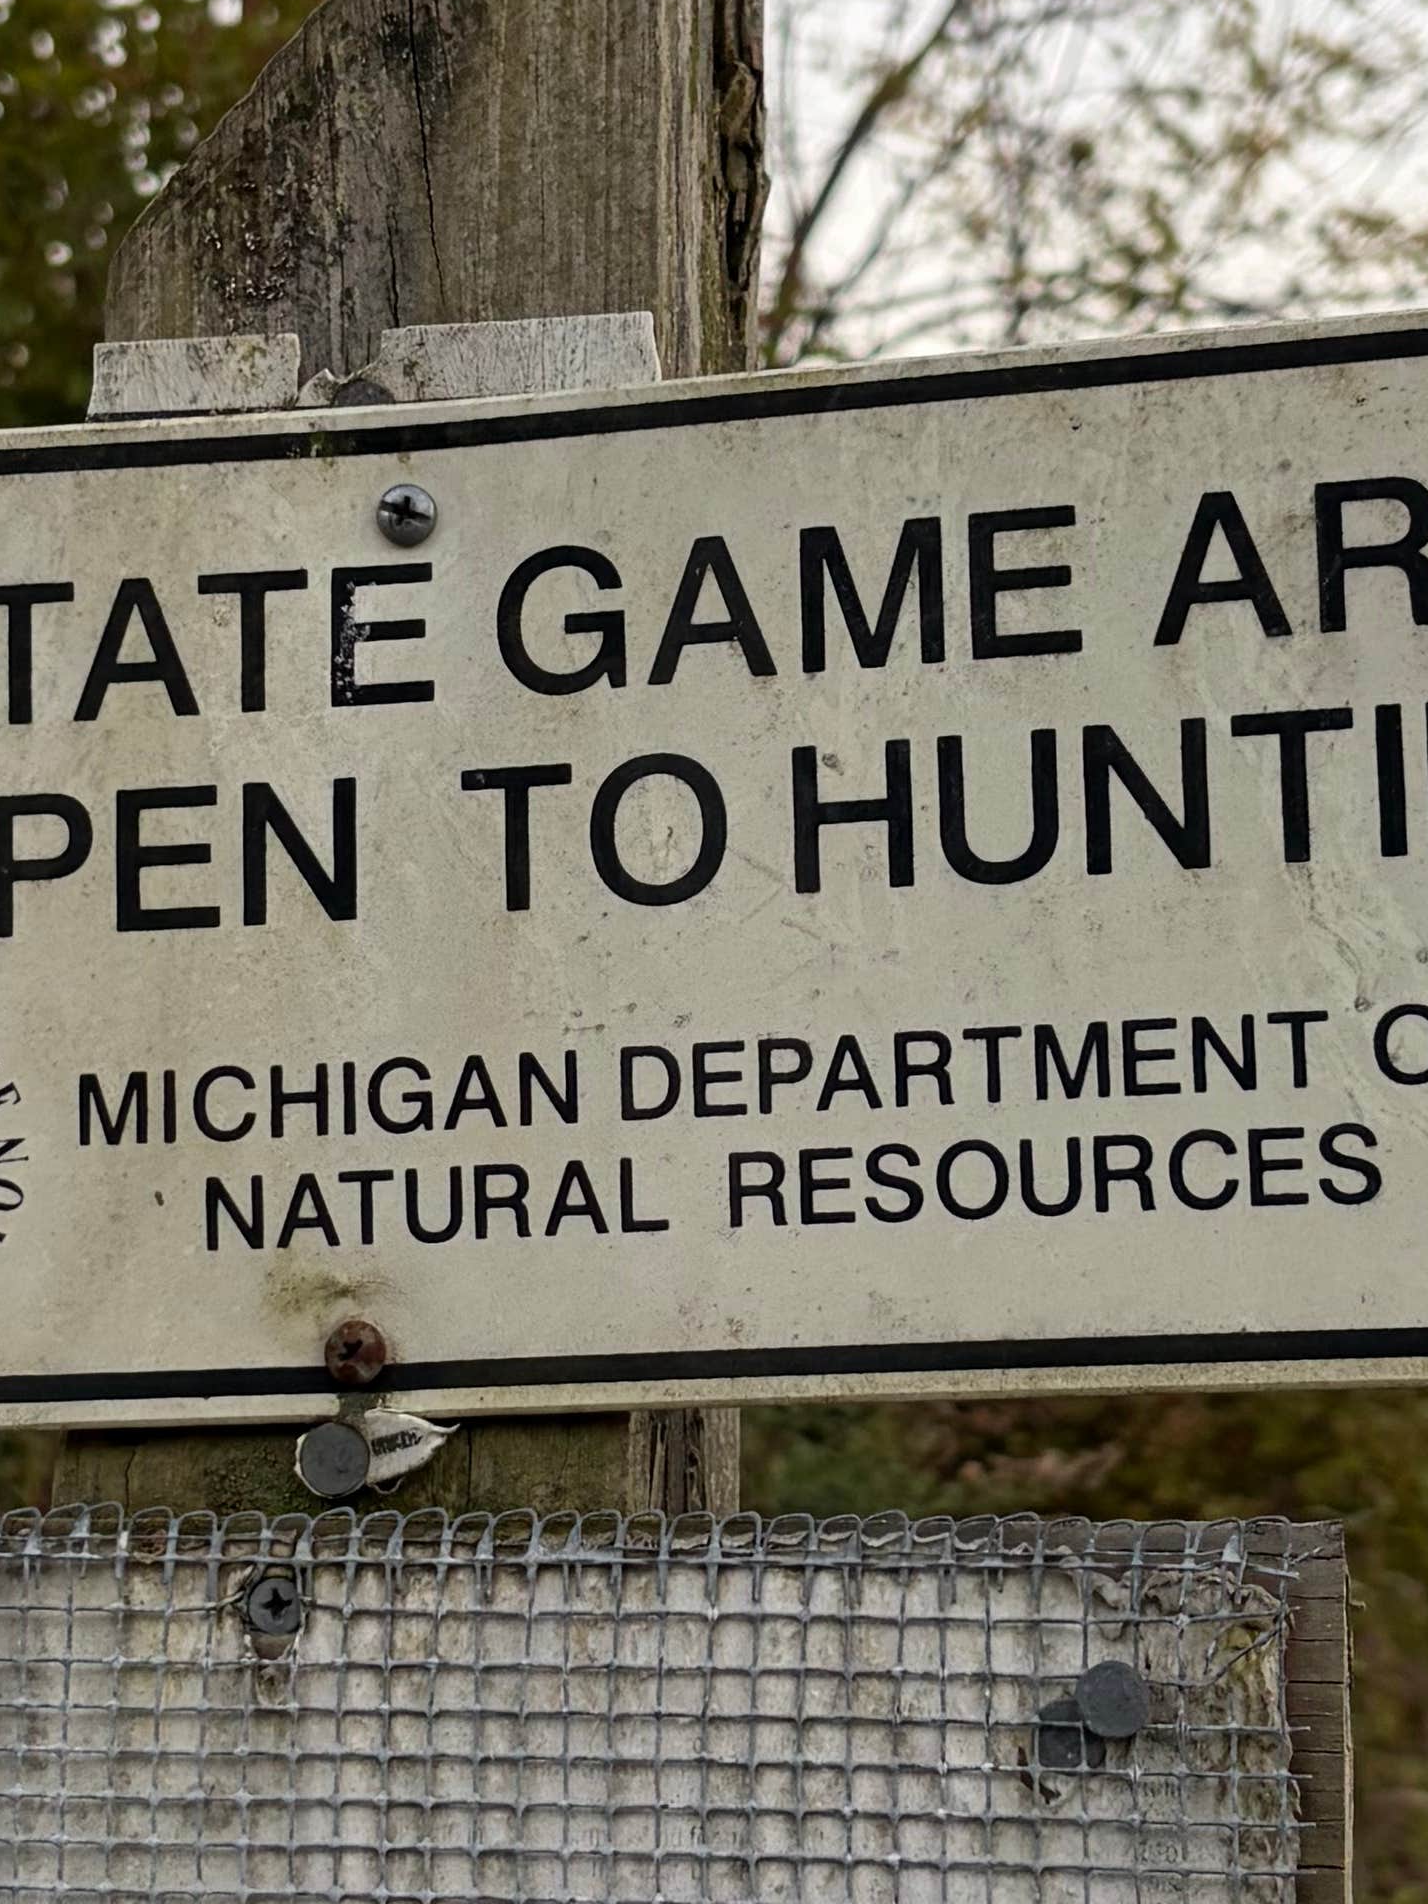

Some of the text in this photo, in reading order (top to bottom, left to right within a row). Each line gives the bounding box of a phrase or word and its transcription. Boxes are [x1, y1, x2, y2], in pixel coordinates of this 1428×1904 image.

[497, 505, 1082, 696] GAME
[461, 753, 727, 911] TO
[79, 1050, 578, 1145] MICHIGAN
[620, 1011, 1328, 1121] DEPARTMENT
[206, 1123, 1381, 1251] NATURAL RESOURCES
